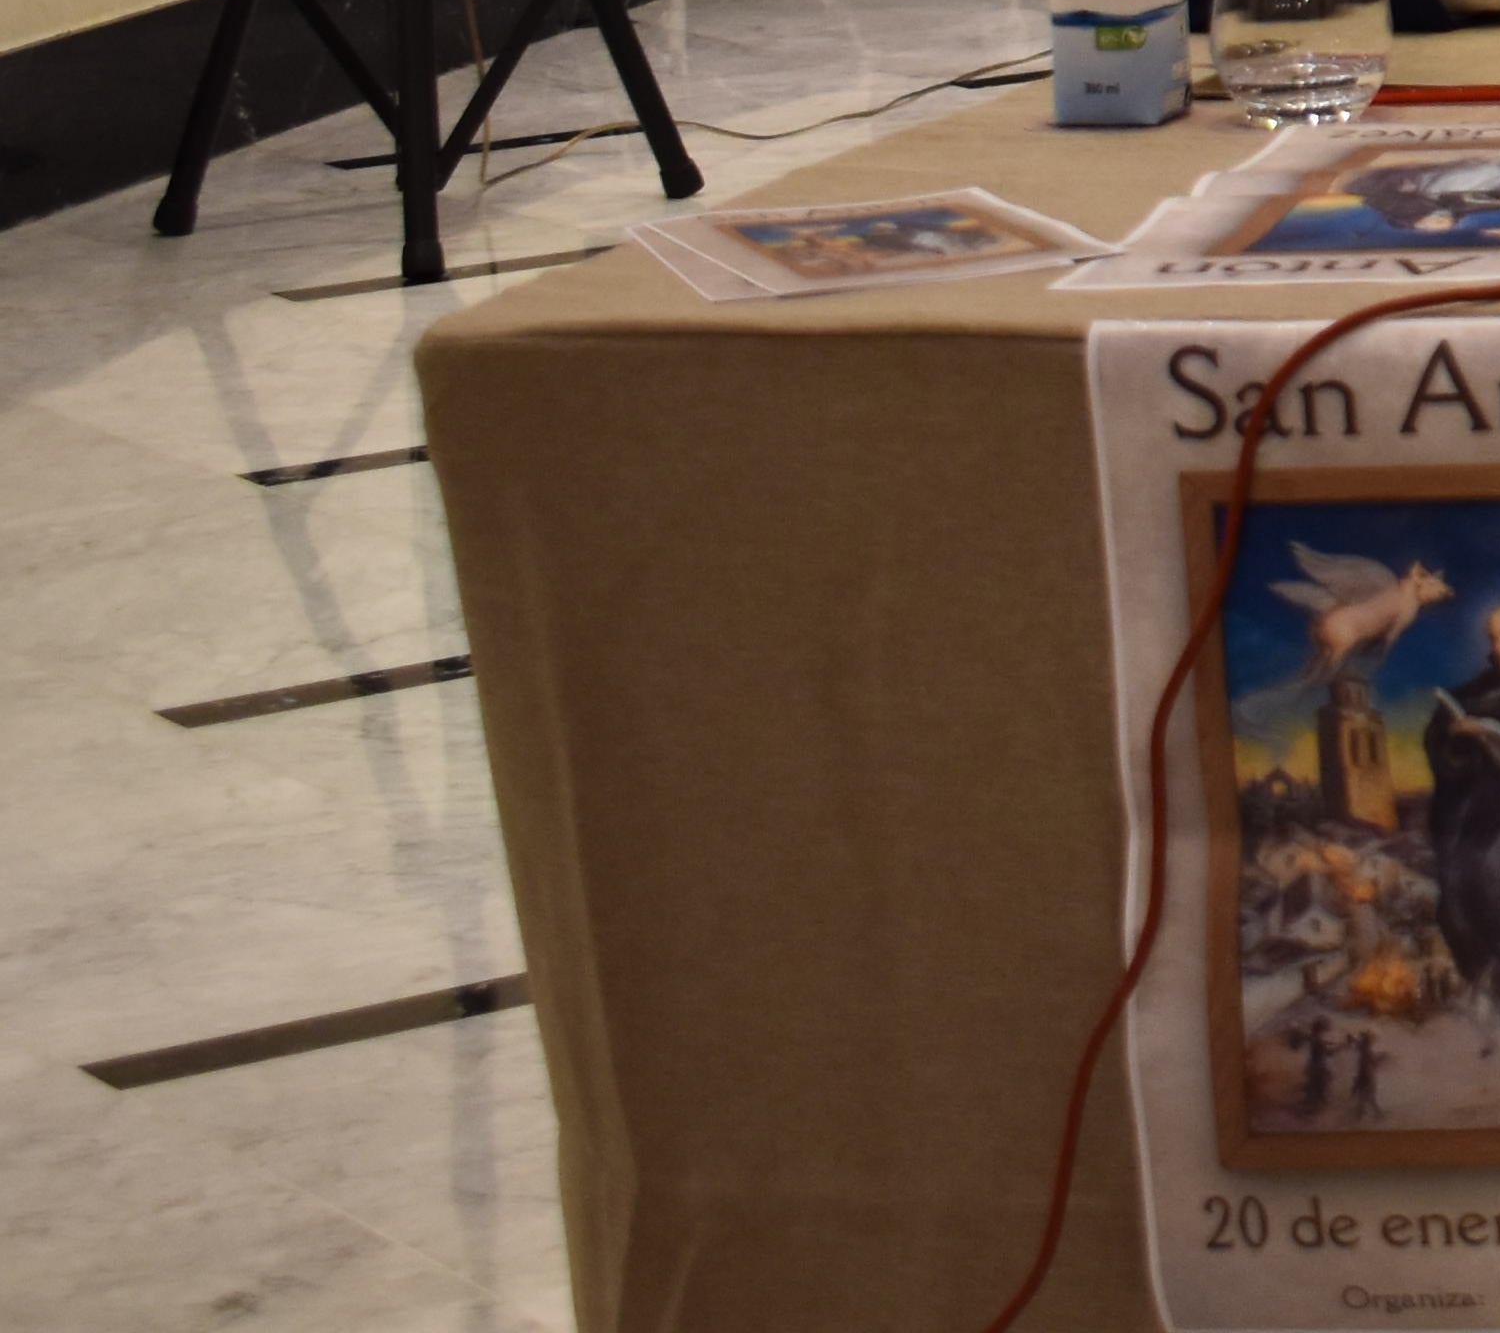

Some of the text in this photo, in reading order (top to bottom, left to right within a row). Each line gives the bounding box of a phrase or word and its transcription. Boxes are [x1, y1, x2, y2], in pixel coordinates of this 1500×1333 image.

[1167, 342, 1360, 440] San
[1201, 1195, 1271, 1253] 20
[1289, 1195, 1361, 1248] de
[1341, 1283, 1486, 1316] Organiza:
